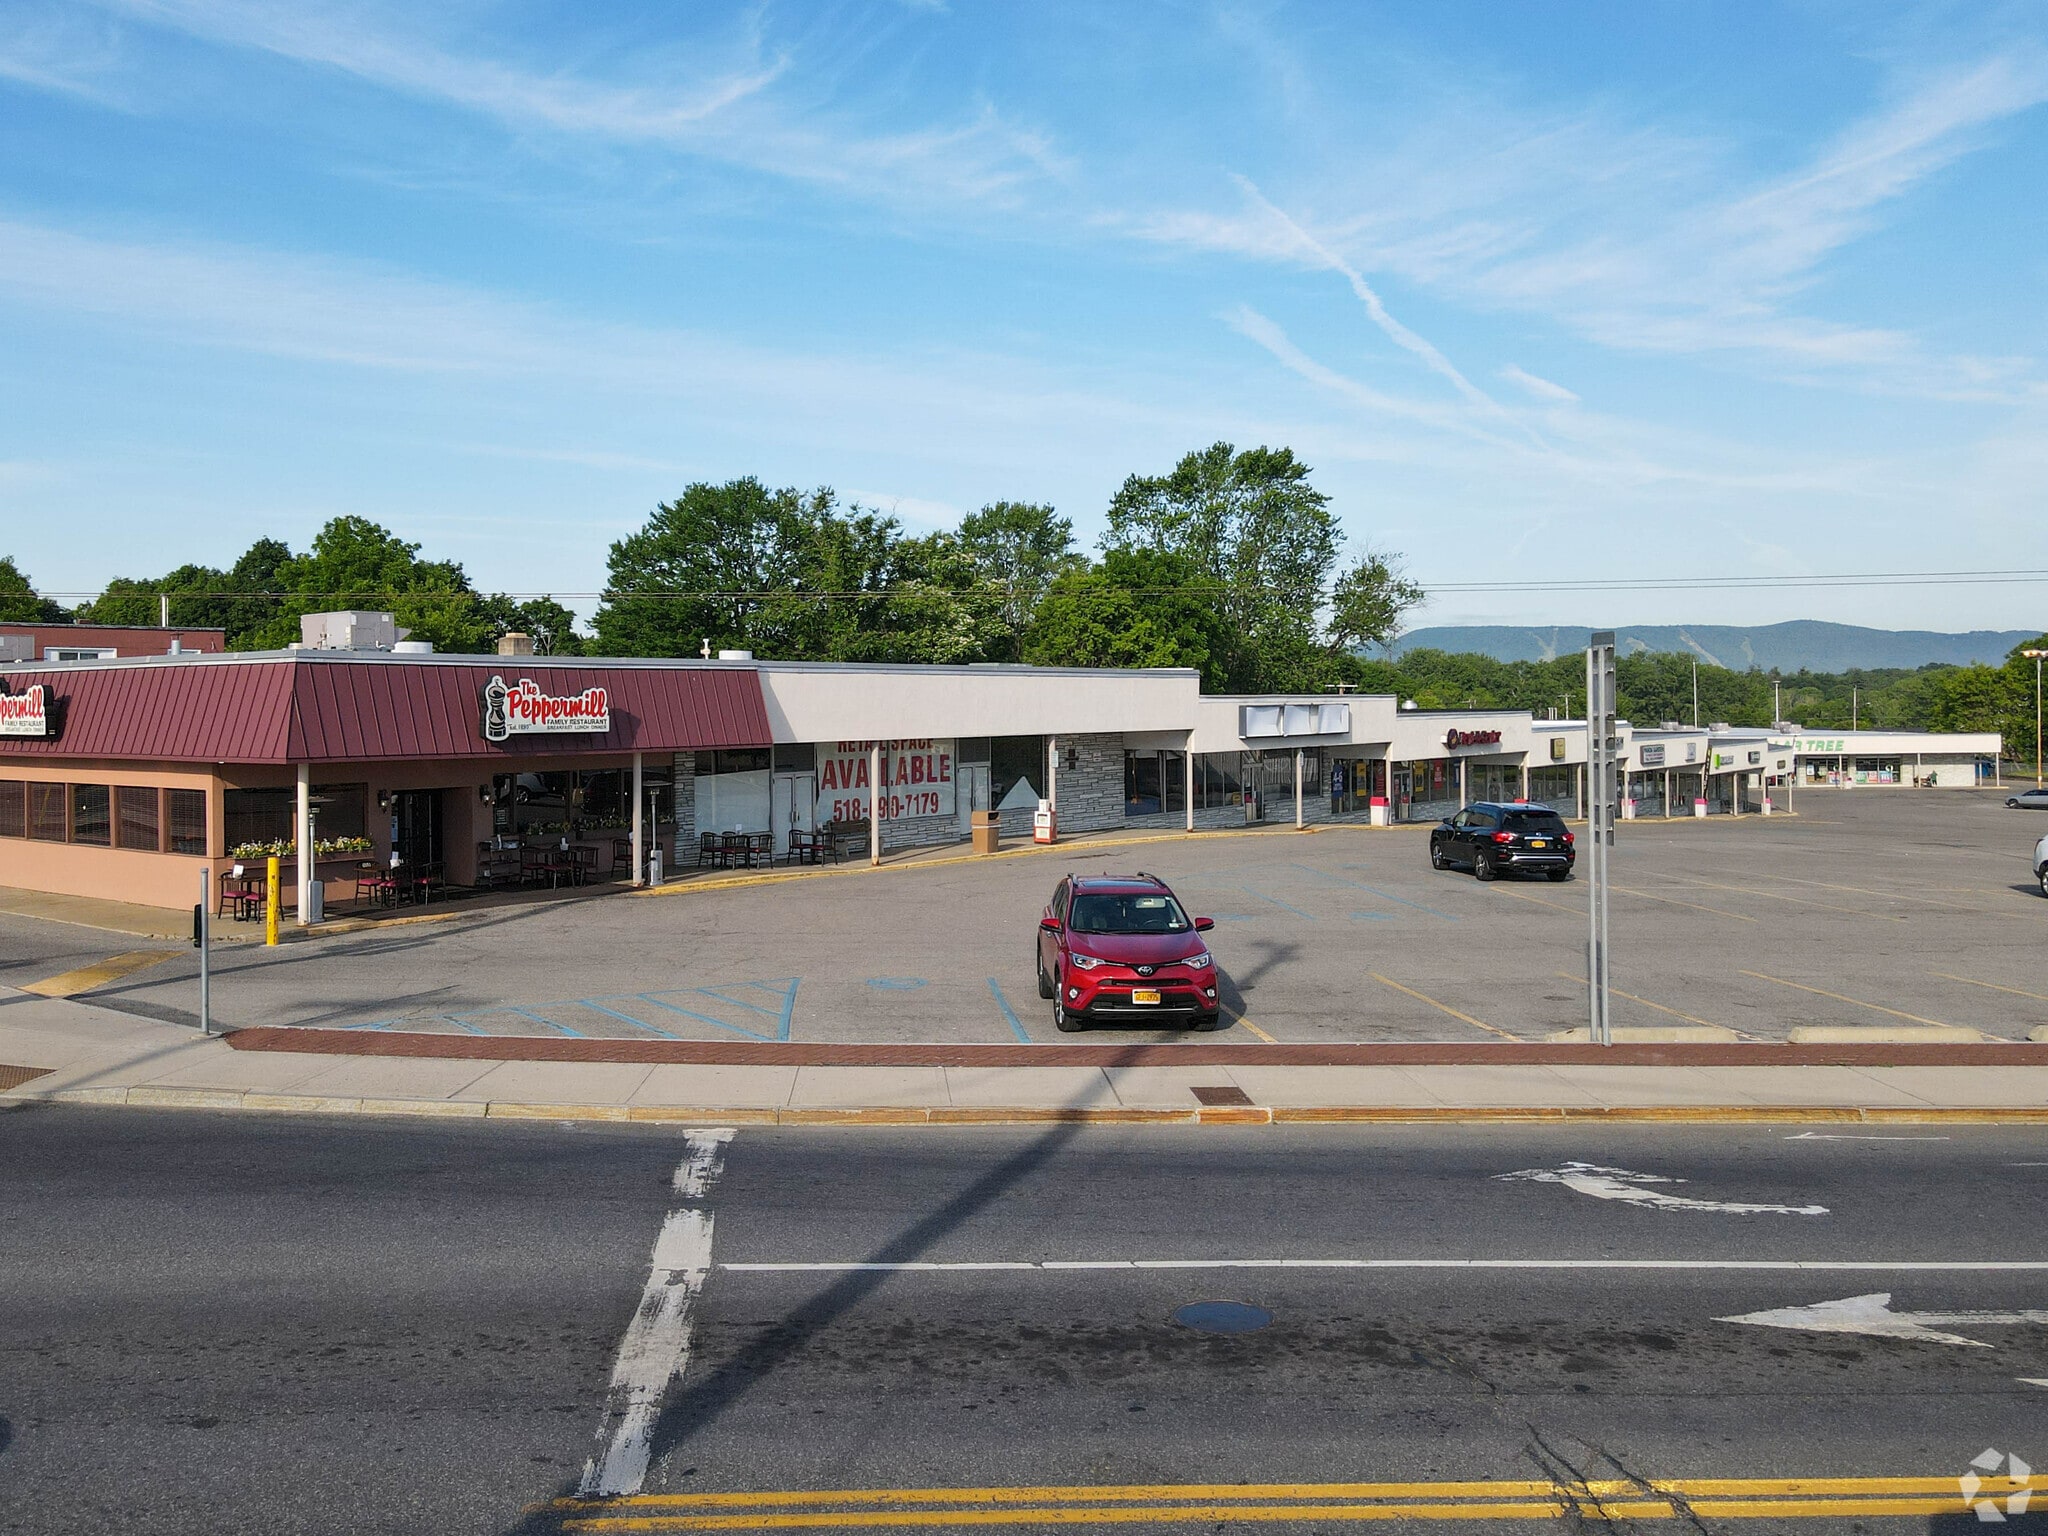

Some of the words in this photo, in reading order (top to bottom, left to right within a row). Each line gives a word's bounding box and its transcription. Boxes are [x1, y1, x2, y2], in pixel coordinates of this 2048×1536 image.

[521, 681, 537, 695] The
[0, 688, 44, 725] permill
[507, 689, 607, 725] Peppermill
[837, 740, 886, 753] RETAL
[891, 738, 934, 752] SPACE
[1806, 739, 1845, 752] TREE
[821, 754, 951, 790] AVALABLE
[833, 792, 939, 821] 518-90-7179
